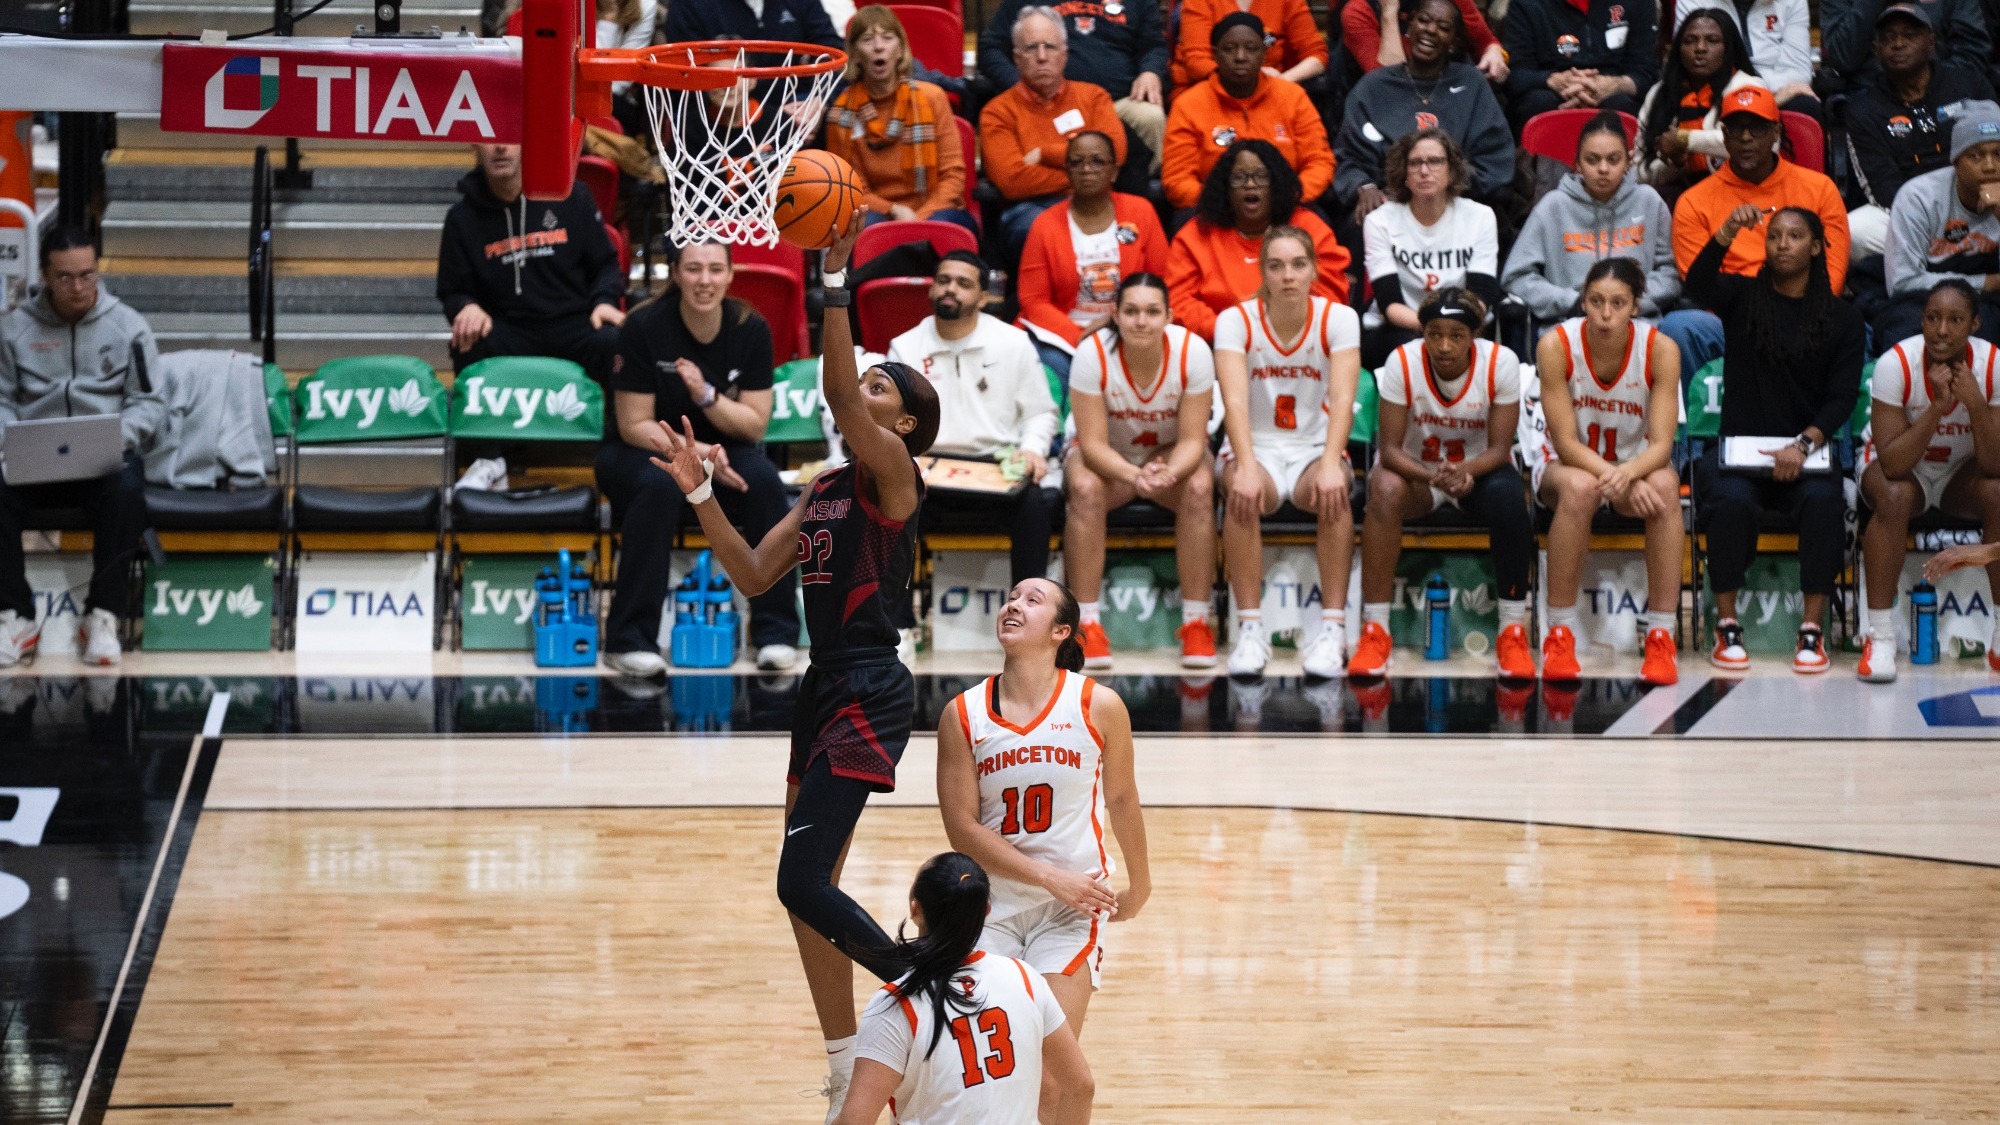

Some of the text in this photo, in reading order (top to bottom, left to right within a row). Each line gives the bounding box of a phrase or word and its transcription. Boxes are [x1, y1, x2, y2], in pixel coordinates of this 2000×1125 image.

[297, 64, 496, 138] TIAA
[1438, 251, 1452, 269] IT
[1456, 246, 1474, 268] IN
[1424, 273, 1439, 292] P
[1251, 364, 1321, 381] PRINCETON
[305, 380, 385, 429] Ivy
[463, 376, 543, 429] Ivy
[1587, 422, 1617, 461] 11
[152, 580, 224, 625] Ivy
[344, 591, 424, 616] TIAA
[1051, 723, 1065, 731] Ivy
[977, 745, 1081, 780] PRINCETON
[1001, 783, 1053, 835] 10
[951, 1006, 1016, 1089] 13
